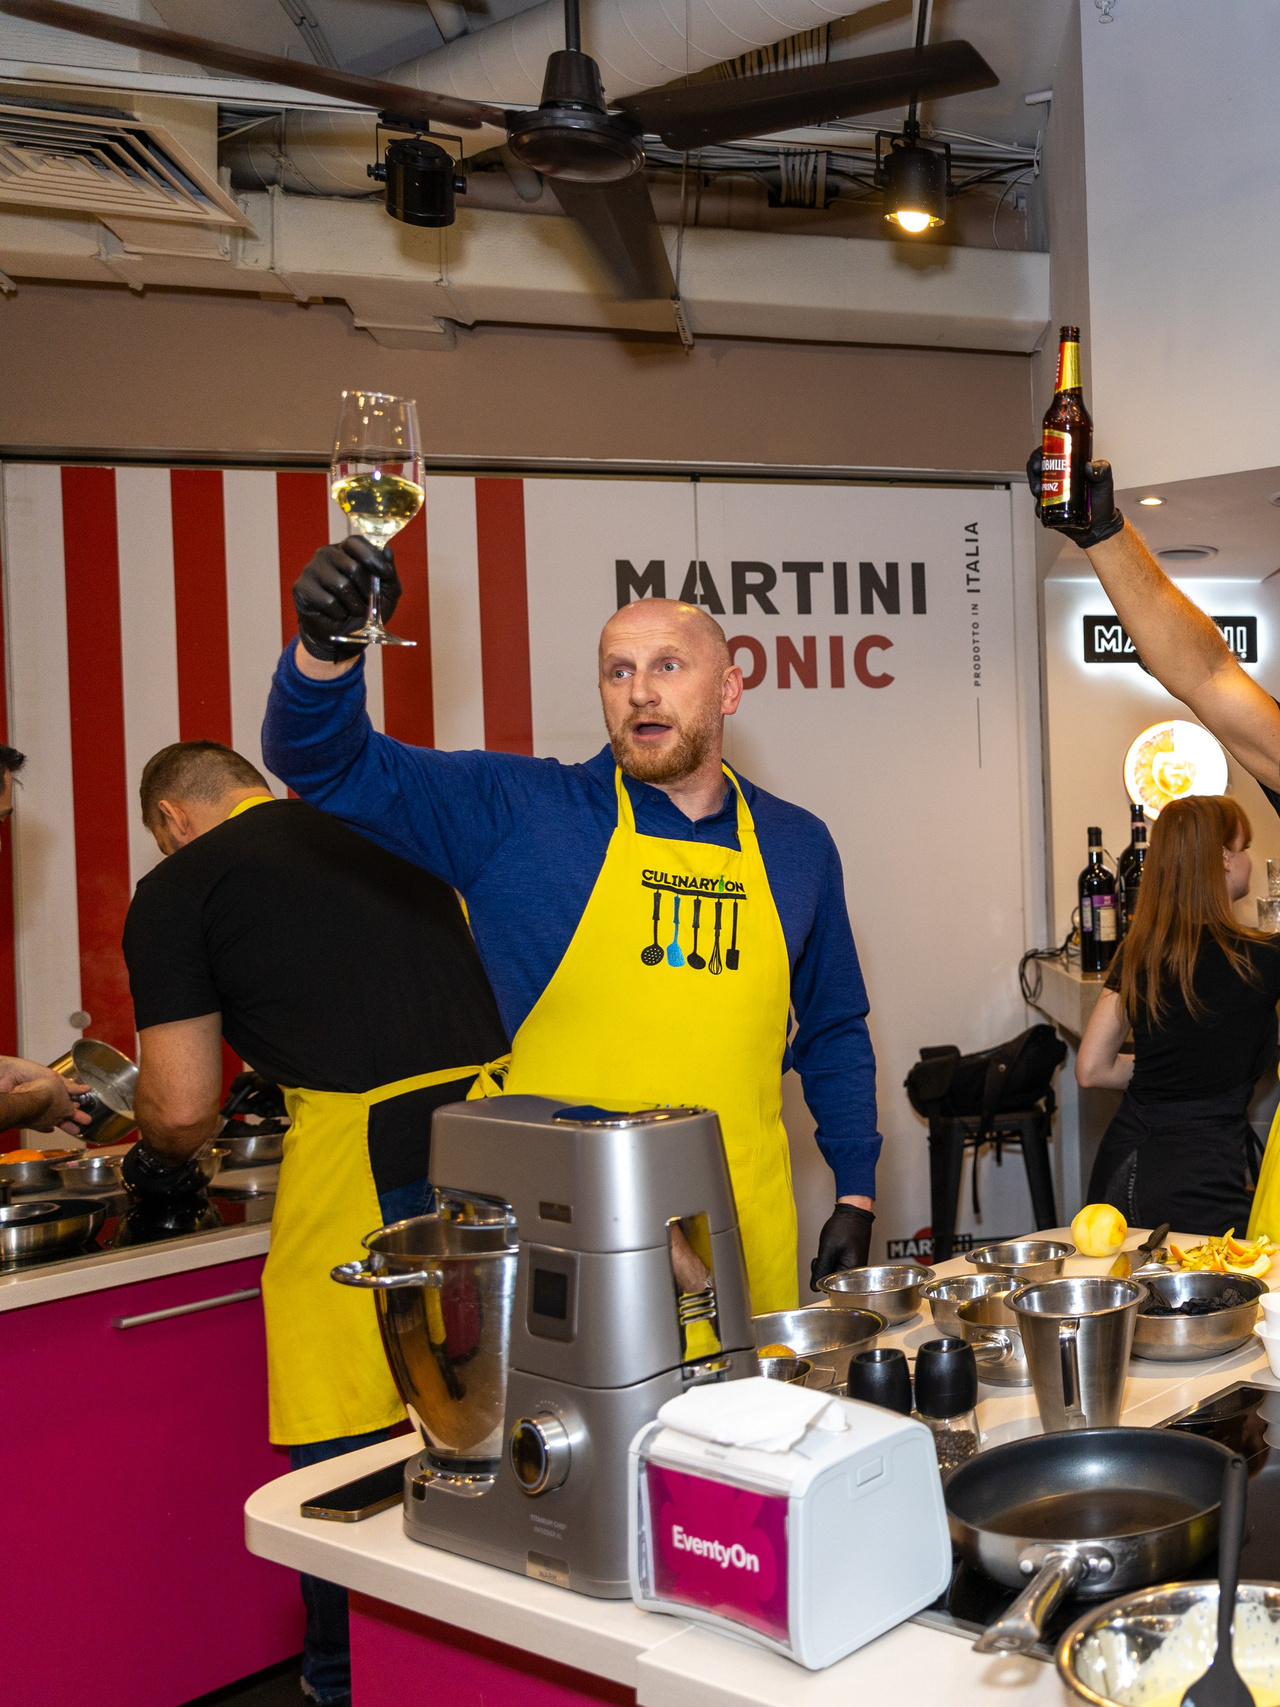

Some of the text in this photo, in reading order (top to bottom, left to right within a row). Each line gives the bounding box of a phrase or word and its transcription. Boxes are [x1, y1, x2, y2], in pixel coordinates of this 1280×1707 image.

[615, 559, 927, 614] MARTINI
[964, 521, 982, 687] PRODOTTO IN ITALIA
[729, 634, 895, 689] ONIC
[671, 1524, 760, 1573] EventyOn
